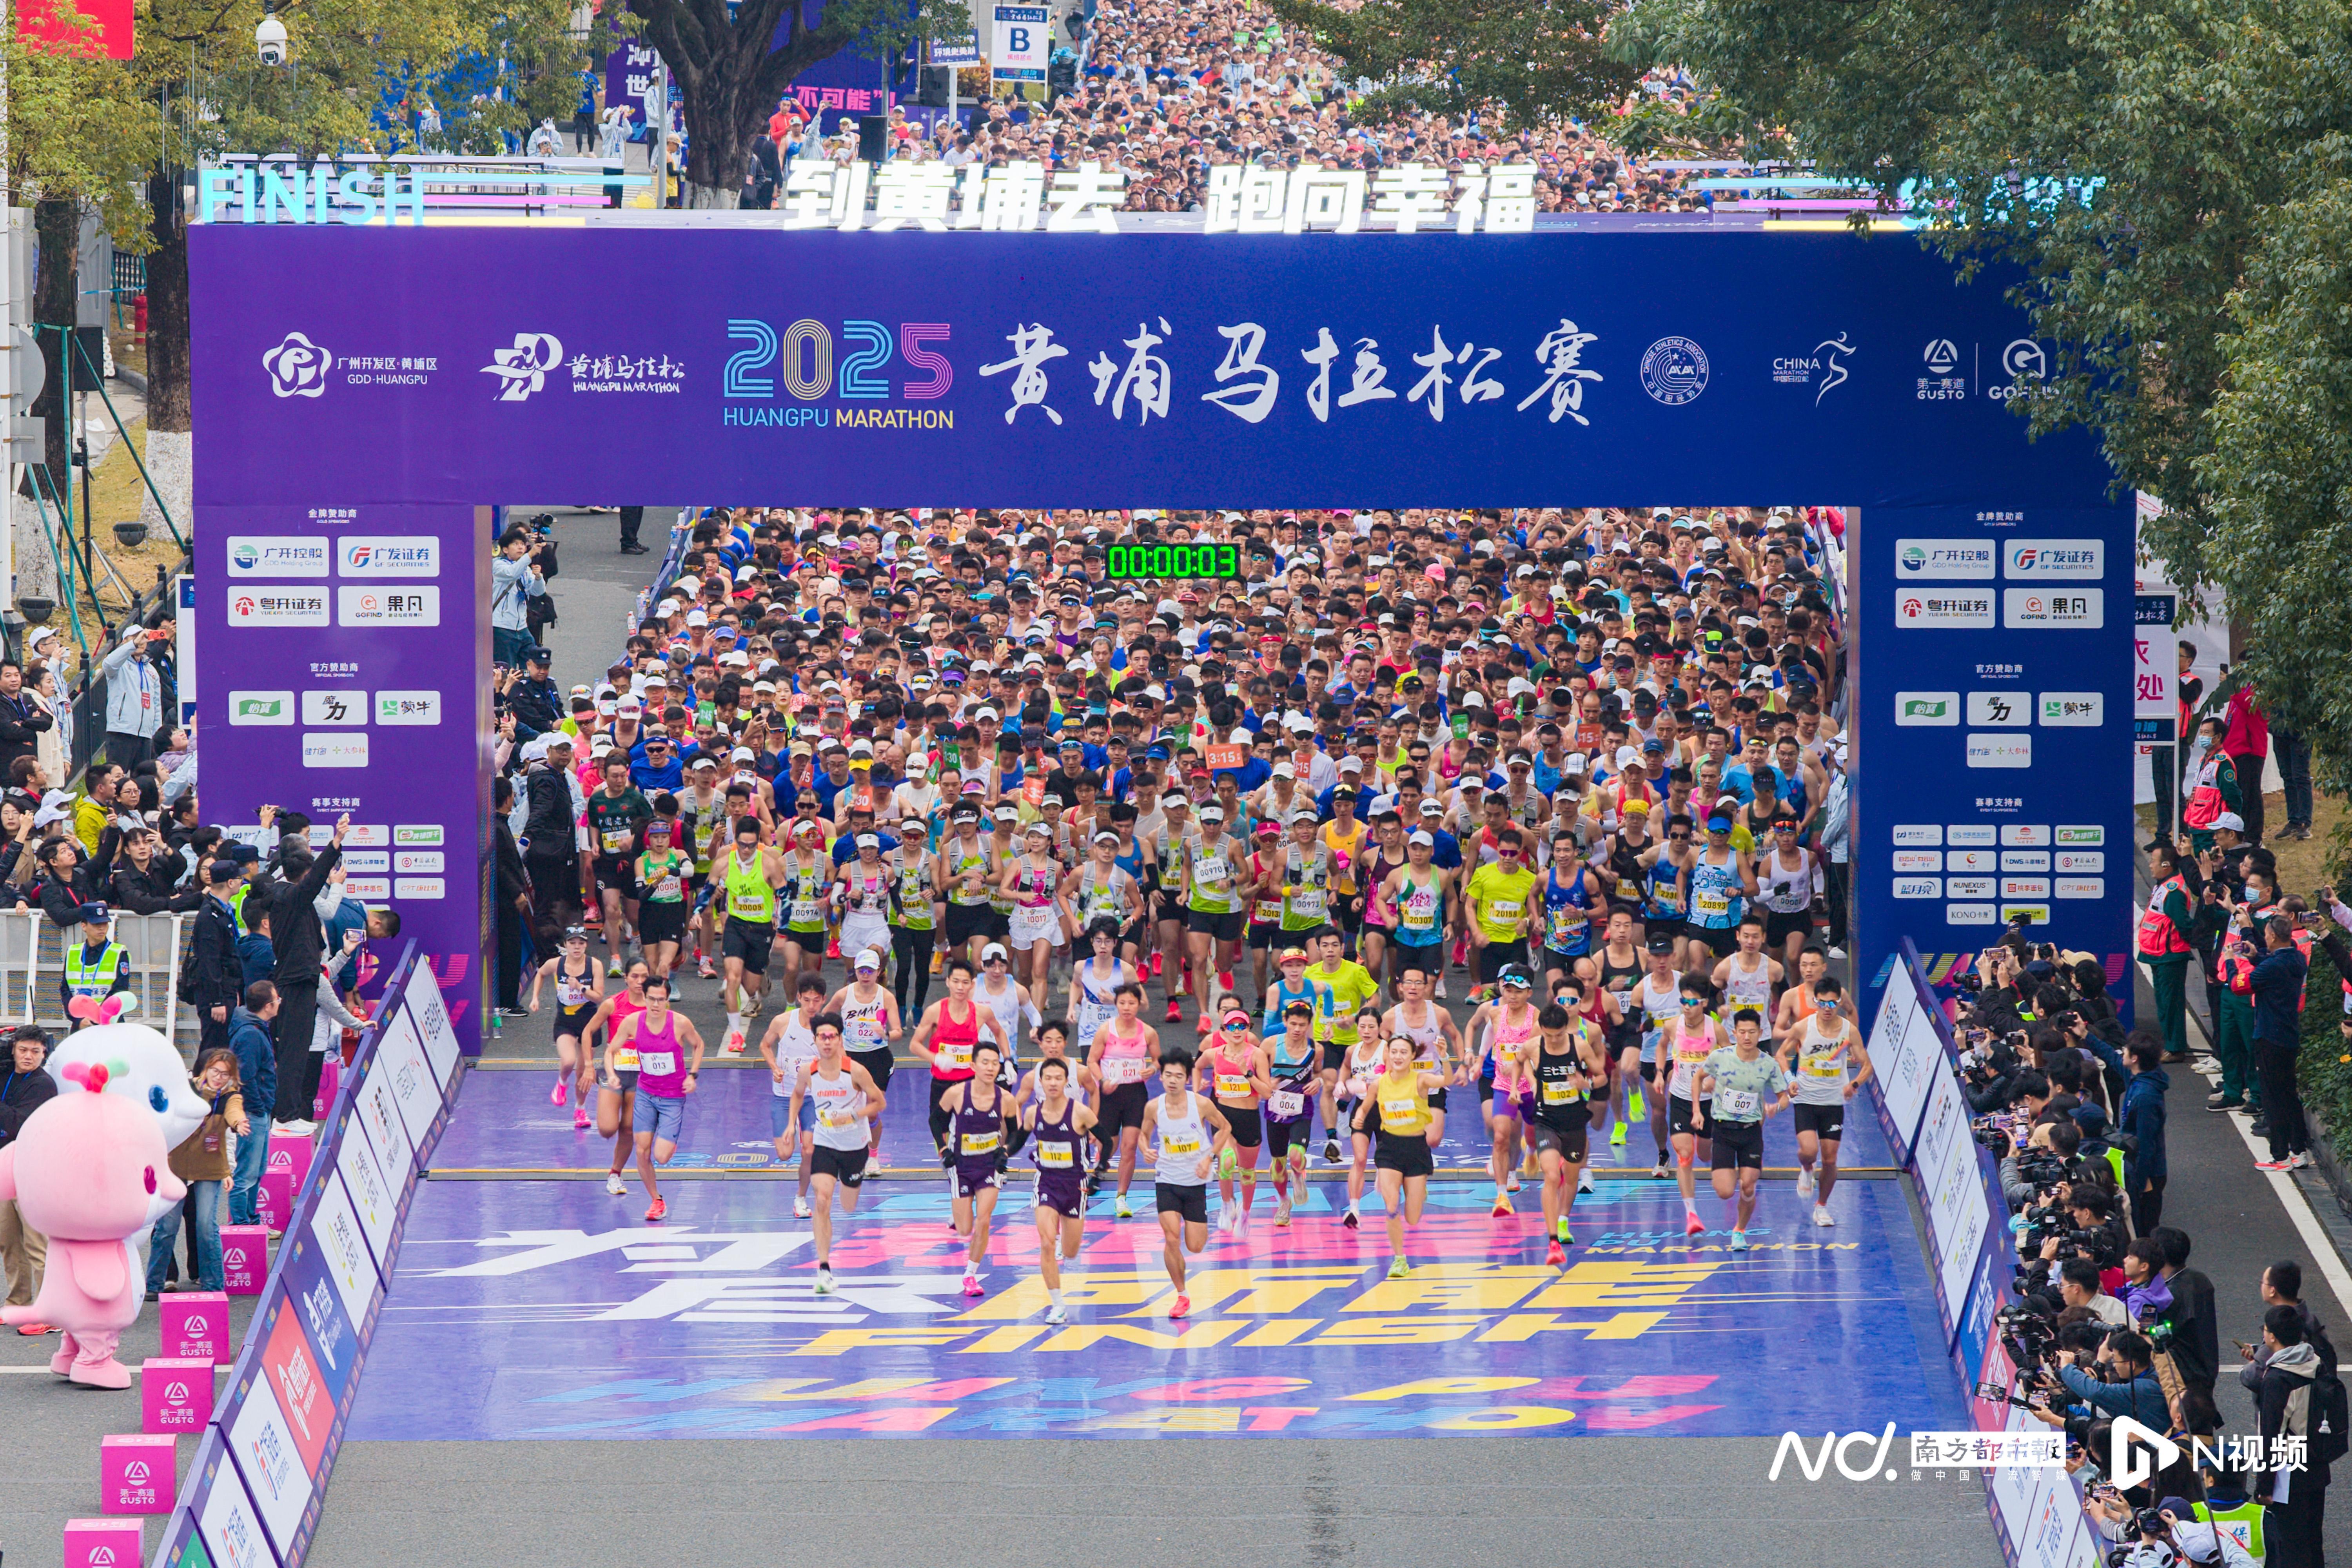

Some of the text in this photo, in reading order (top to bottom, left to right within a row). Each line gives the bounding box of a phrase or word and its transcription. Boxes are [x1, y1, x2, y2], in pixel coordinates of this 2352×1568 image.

[1010, 27, 1031, 51] B
[626, 74, 649, 97] 世
[202, 169, 424, 226] FINISH
[784, 160, 1537, 233] 到黄埔去 跑向幸福
[724, 319, 953, 399] 2025
[1643, 339, 1707, 374] CHINESE ATHLETICS ASSOCIATION
[565, 354, 685, 380] 黄埔马拉松
[1773, 358, 1821, 370] CHINA
[980, 317, 1603, 426] 黄埔马拉松赛
[347, 374, 428, 385] GDD-HUANGPU
[1917, 377, 1965, 389] 第一赛道
[573, 381, 681, 394] HUANGPU MARATHON
[1917, 390, 1965, 399] GUSTO
[724, 407, 954, 430] HUANGPU MARATHON
[264, 548, 323, 559] 广开控股
[375, 548, 429, 560] 广发证券
[1932, 550, 1989, 561] 广开控股
[2040, 550, 2094, 563] 广发证券
[1109, 546, 1236, 577] 00:00:03
[260, 598, 323, 610] 粤开证券
[388, 595, 423, 611] 果凡
[1927, 600, 1988, 611] 粤开证券
[2053, 598, 2087, 613] 果凡
[2136, 673, 2163, 701] 处
[322, 695, 348, 720] 魔力
[401, 701, 431, 715] 蒙牛
[1987, 696, 2011, 721] 魔力
[2064, 702, 2093, 716] 蒙牛
[343, 746, 366, 754] 大参林
[2007, 746, 2029, 755] 大参林
[312, 797, 361, 808] 赛事支持商
[1975, 797, 2023, 807] 赛事支持商
[1200, 866, 1222, 877] 00970
[1901, 884, 1933, 895] 蓝月亮
[1702, 901, 1726, 909] 20893
[1027, 915, 1047, 923] 10017
[1951, 911, 1976, 919] KONO
[858, 1029, 873, 1037] 022
[1279, 1101, 1295, 1111] 004
[1735, 1100, 1751, 1109] 007
[1178, 1143, 1192, 1152] 107
[1050, 1152, 1062, 1161] 112
[1592, 1240, 1661, 1248] PU
[784, 1311, 1669, 1356] FINISH
[524, 1375, 1720, 1403] HUANG PU
[160, 1408, 194, 1417] 第一赛道
